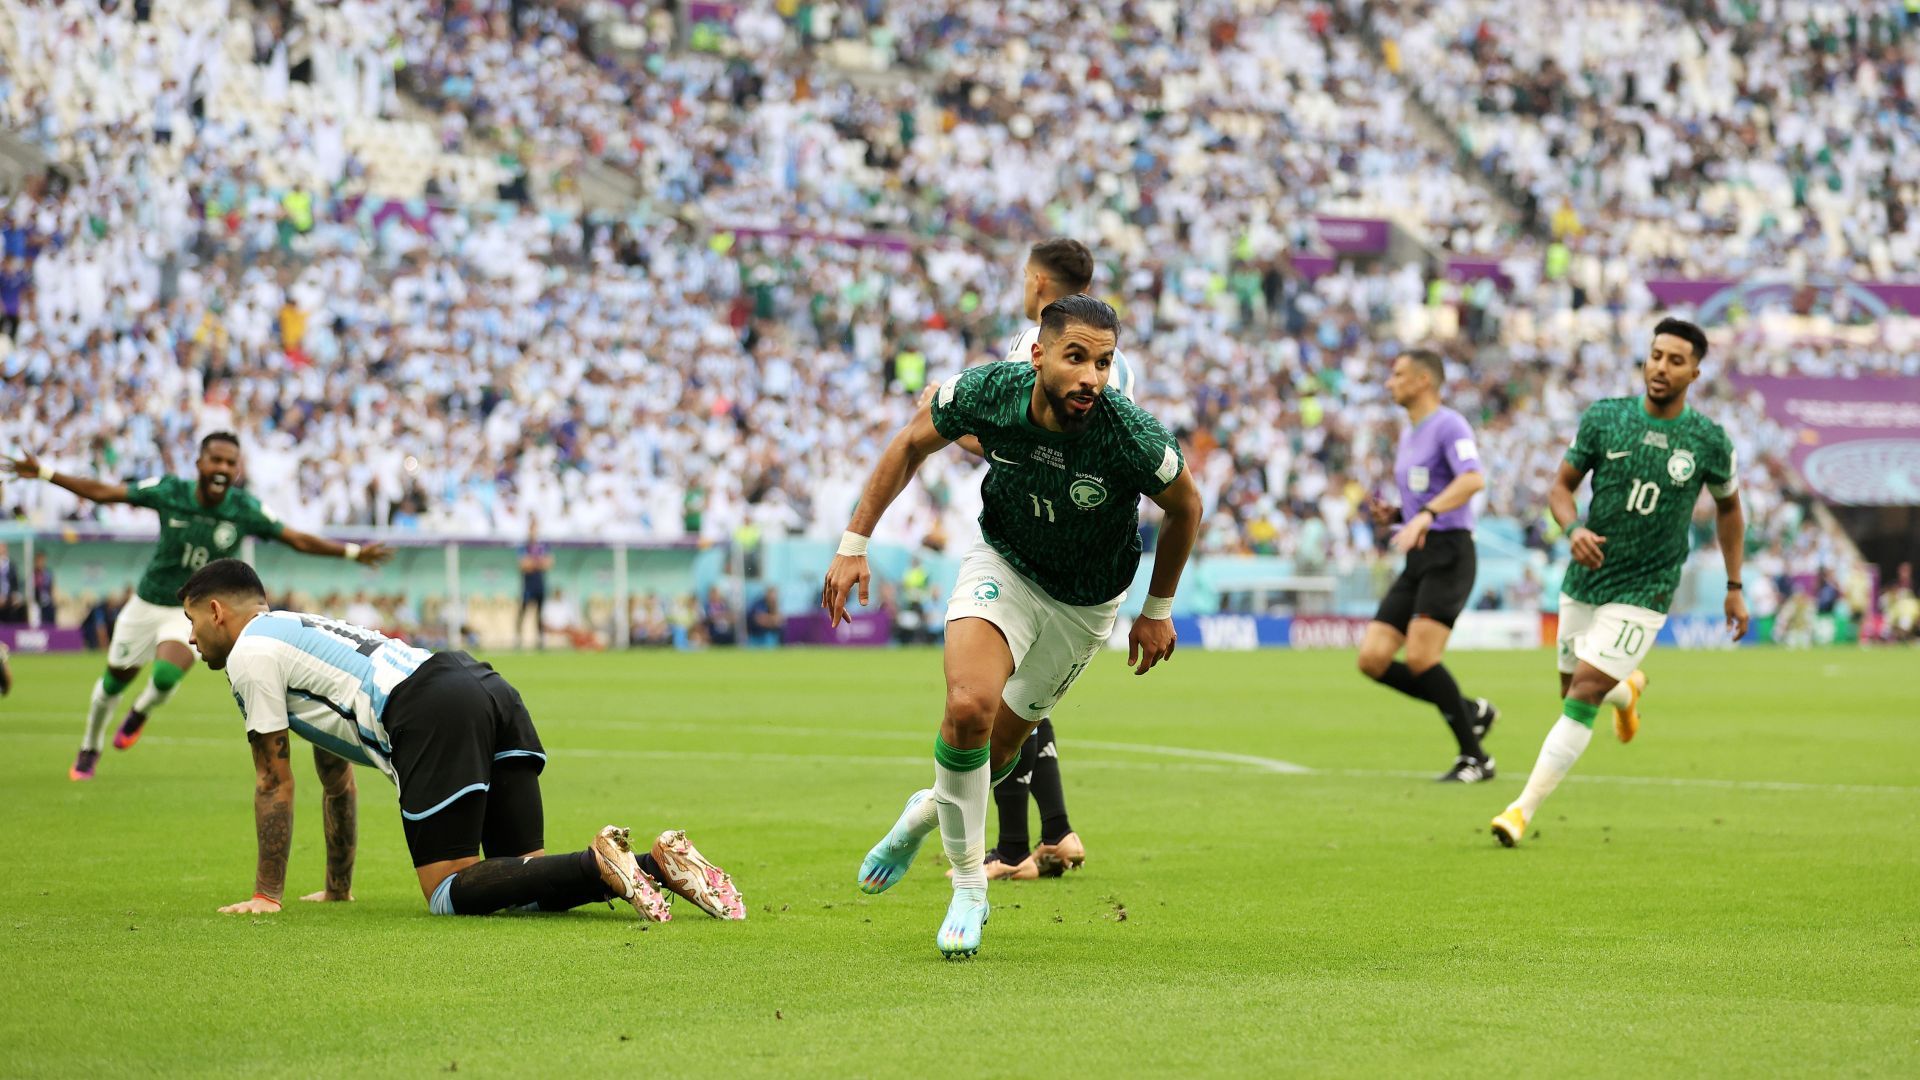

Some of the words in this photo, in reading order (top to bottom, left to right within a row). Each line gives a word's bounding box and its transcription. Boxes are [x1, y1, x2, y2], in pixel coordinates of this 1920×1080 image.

[1029, 493, 1055, 522] 11
[1626, 478, 1660, 515] 10
[181, 542, 209, 571] 18
[1614, 620, 1645, 656] 10
